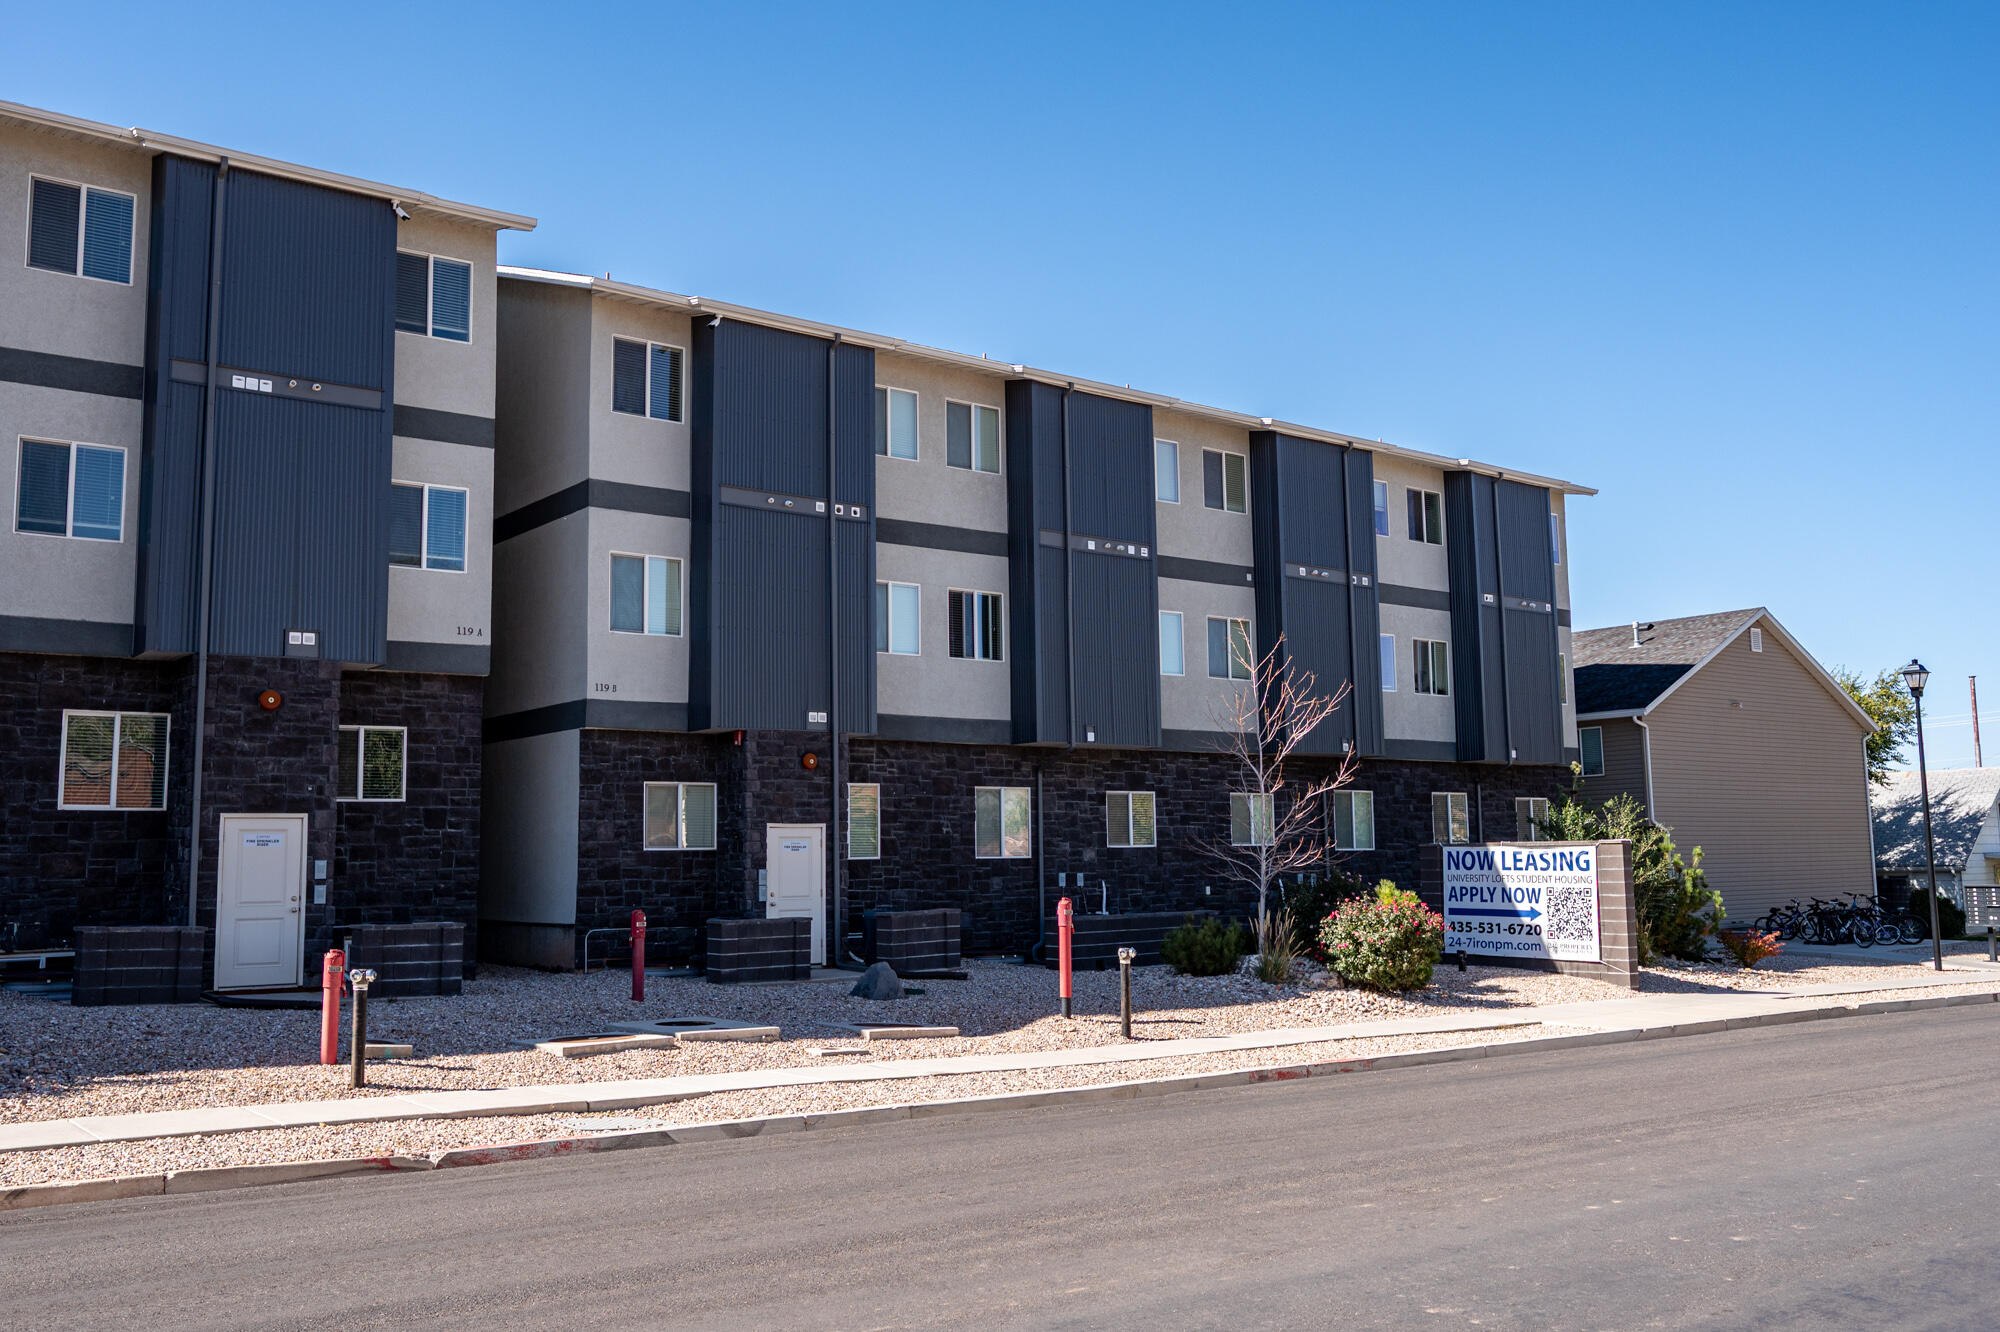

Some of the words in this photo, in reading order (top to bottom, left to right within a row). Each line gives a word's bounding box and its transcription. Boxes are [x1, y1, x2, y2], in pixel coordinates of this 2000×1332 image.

[456, 626, 474, 636] 119
[476, 627, 483, 637] A
[595, 683, 610, 692] 119
[1447, 850, 1495, 871] NOW
[1501, 850, 1591, 872] LEASING
[1447, 873, 1490, 883] UNIVERSITY
[1491, 874, 1515, 883] LOFTS
[1516, 875, 1552, 884] STUDENT
[1554, 875, 1593, 885] HOUSING
[1448, 886, 1497, 903] APPLY
[1501, 887, 1542, 904] NOW
[1449, 920, 1542, 936] 435-531-6720
[1448, 936, 1542, 952] 24-7ironpm.com
